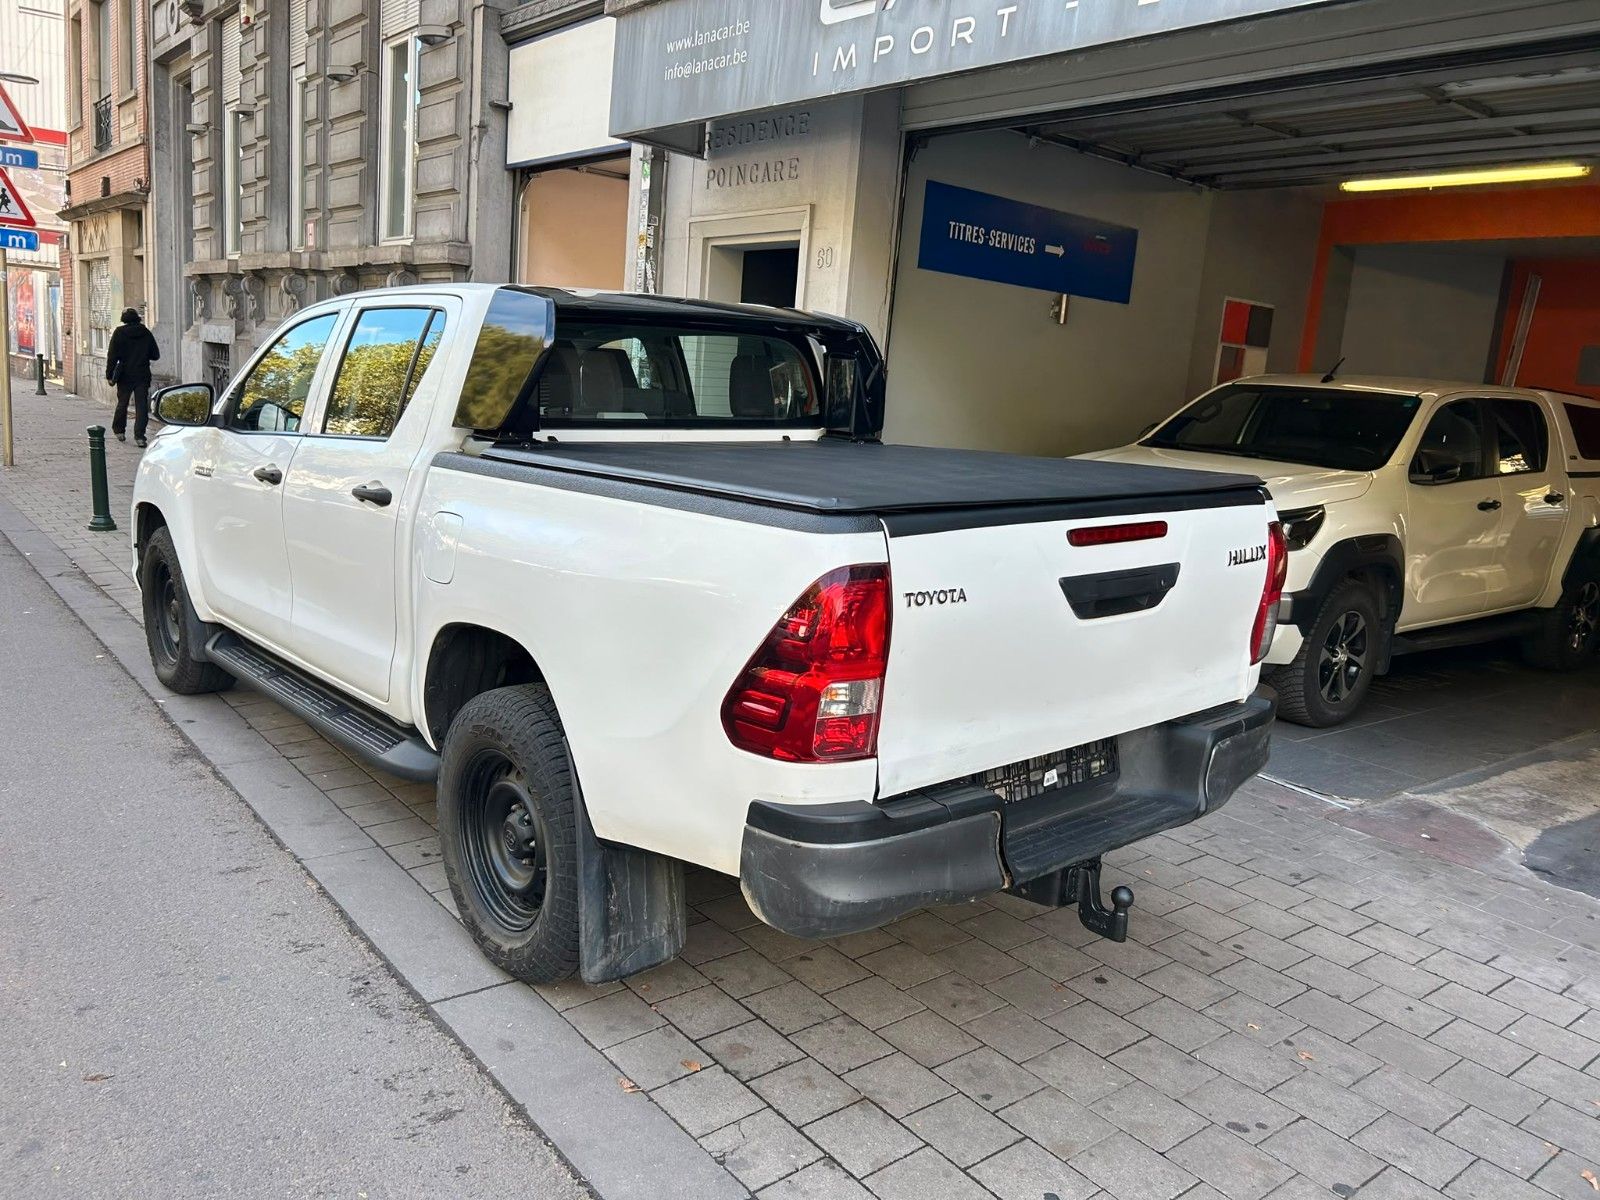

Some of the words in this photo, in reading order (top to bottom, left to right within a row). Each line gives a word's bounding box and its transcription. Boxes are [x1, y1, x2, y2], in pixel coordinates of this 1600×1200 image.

[666, 18, 750, 54] www.lanacar.be
[813, 6, 1017, 76] IMPORT
[664, 48, 748, 80] info@lanacar.be
[1228, 545, 1266, 566] HILUX
[904, 588, 967, 608] TOYOTA
